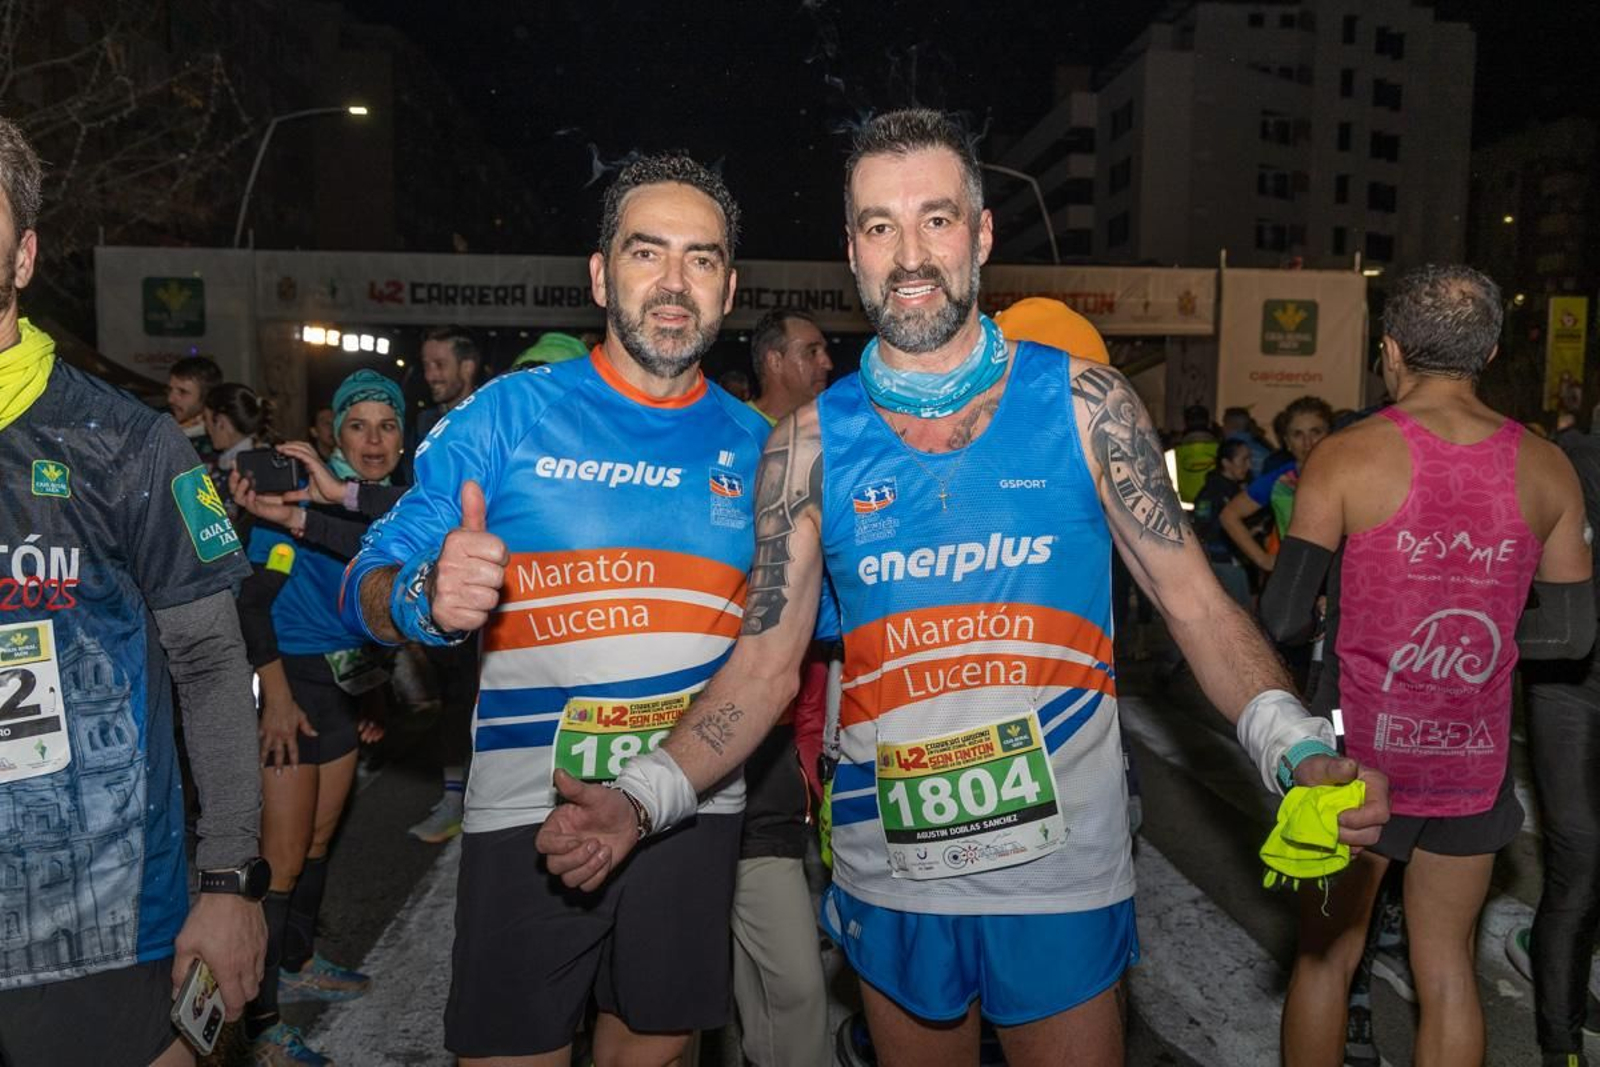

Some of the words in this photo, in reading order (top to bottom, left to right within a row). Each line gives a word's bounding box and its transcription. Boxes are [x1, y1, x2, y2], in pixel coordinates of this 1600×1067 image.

[368, 281, 405, 305] 42
[410, 282, 526, 306] CARRERA
[739, 287, 852, 311] ACIONAL
[1249, 370, 1323, 382] calderón
[535, 456, 682, 487] enerplus
[1000, 479, 1047, 489] GSPORT
[517, 552, 655, 593] Maratón
[858, 533, 1053, 585] enerplus
[0, 576, 82, 611] 2025
[528, 603, 649, 641] Lucena
[886, 605, 1034, 653] Maratón
[904, 660, 1027, 698] Lucena
[597, 706, 628, 728] 42
[571, 730, 669, 777] 18
[896, 746, 930, 771] 42
[928, 752, 954, 766] SAN
[887, 755, 1042, 828] 1804
